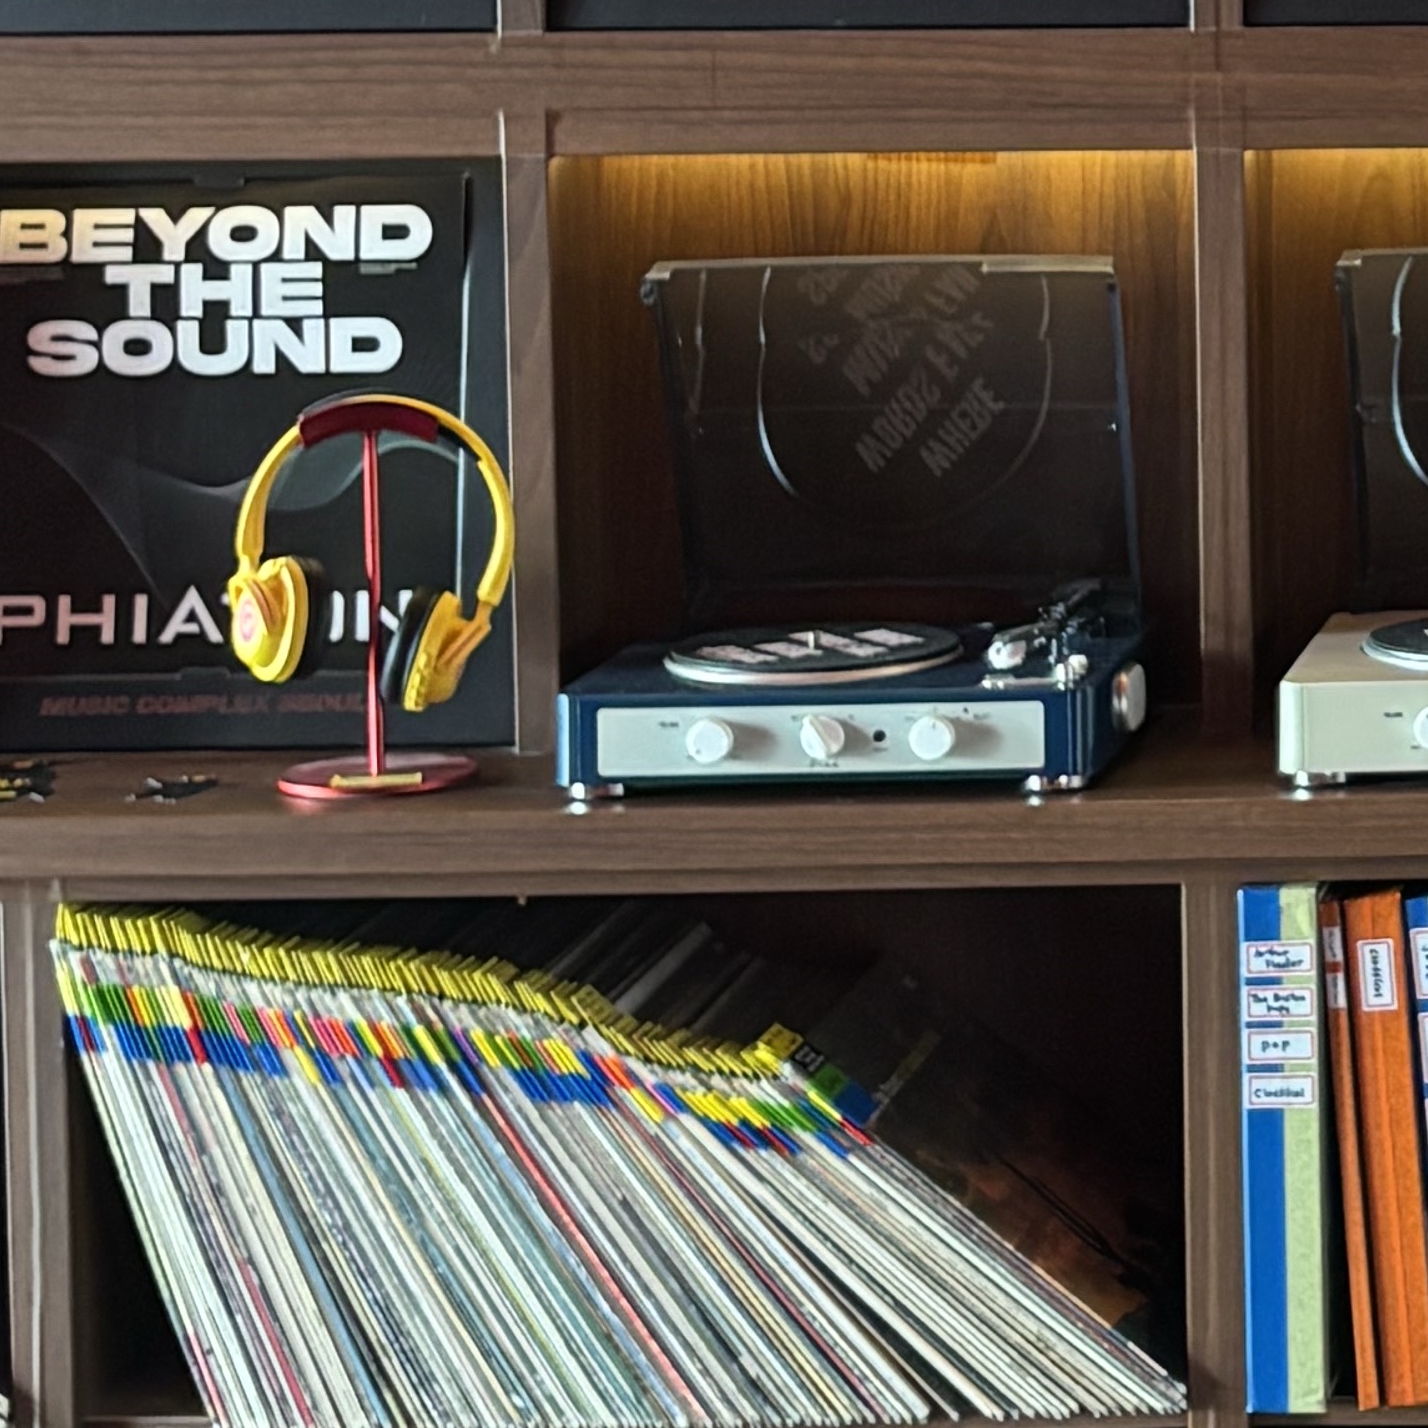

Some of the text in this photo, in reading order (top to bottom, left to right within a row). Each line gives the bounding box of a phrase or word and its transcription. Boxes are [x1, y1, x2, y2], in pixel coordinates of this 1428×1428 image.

[0, 205, 433, 262] BEYOND
[105, 262, 323, 317] THE
[26, 318, 402, 376] SOUND
